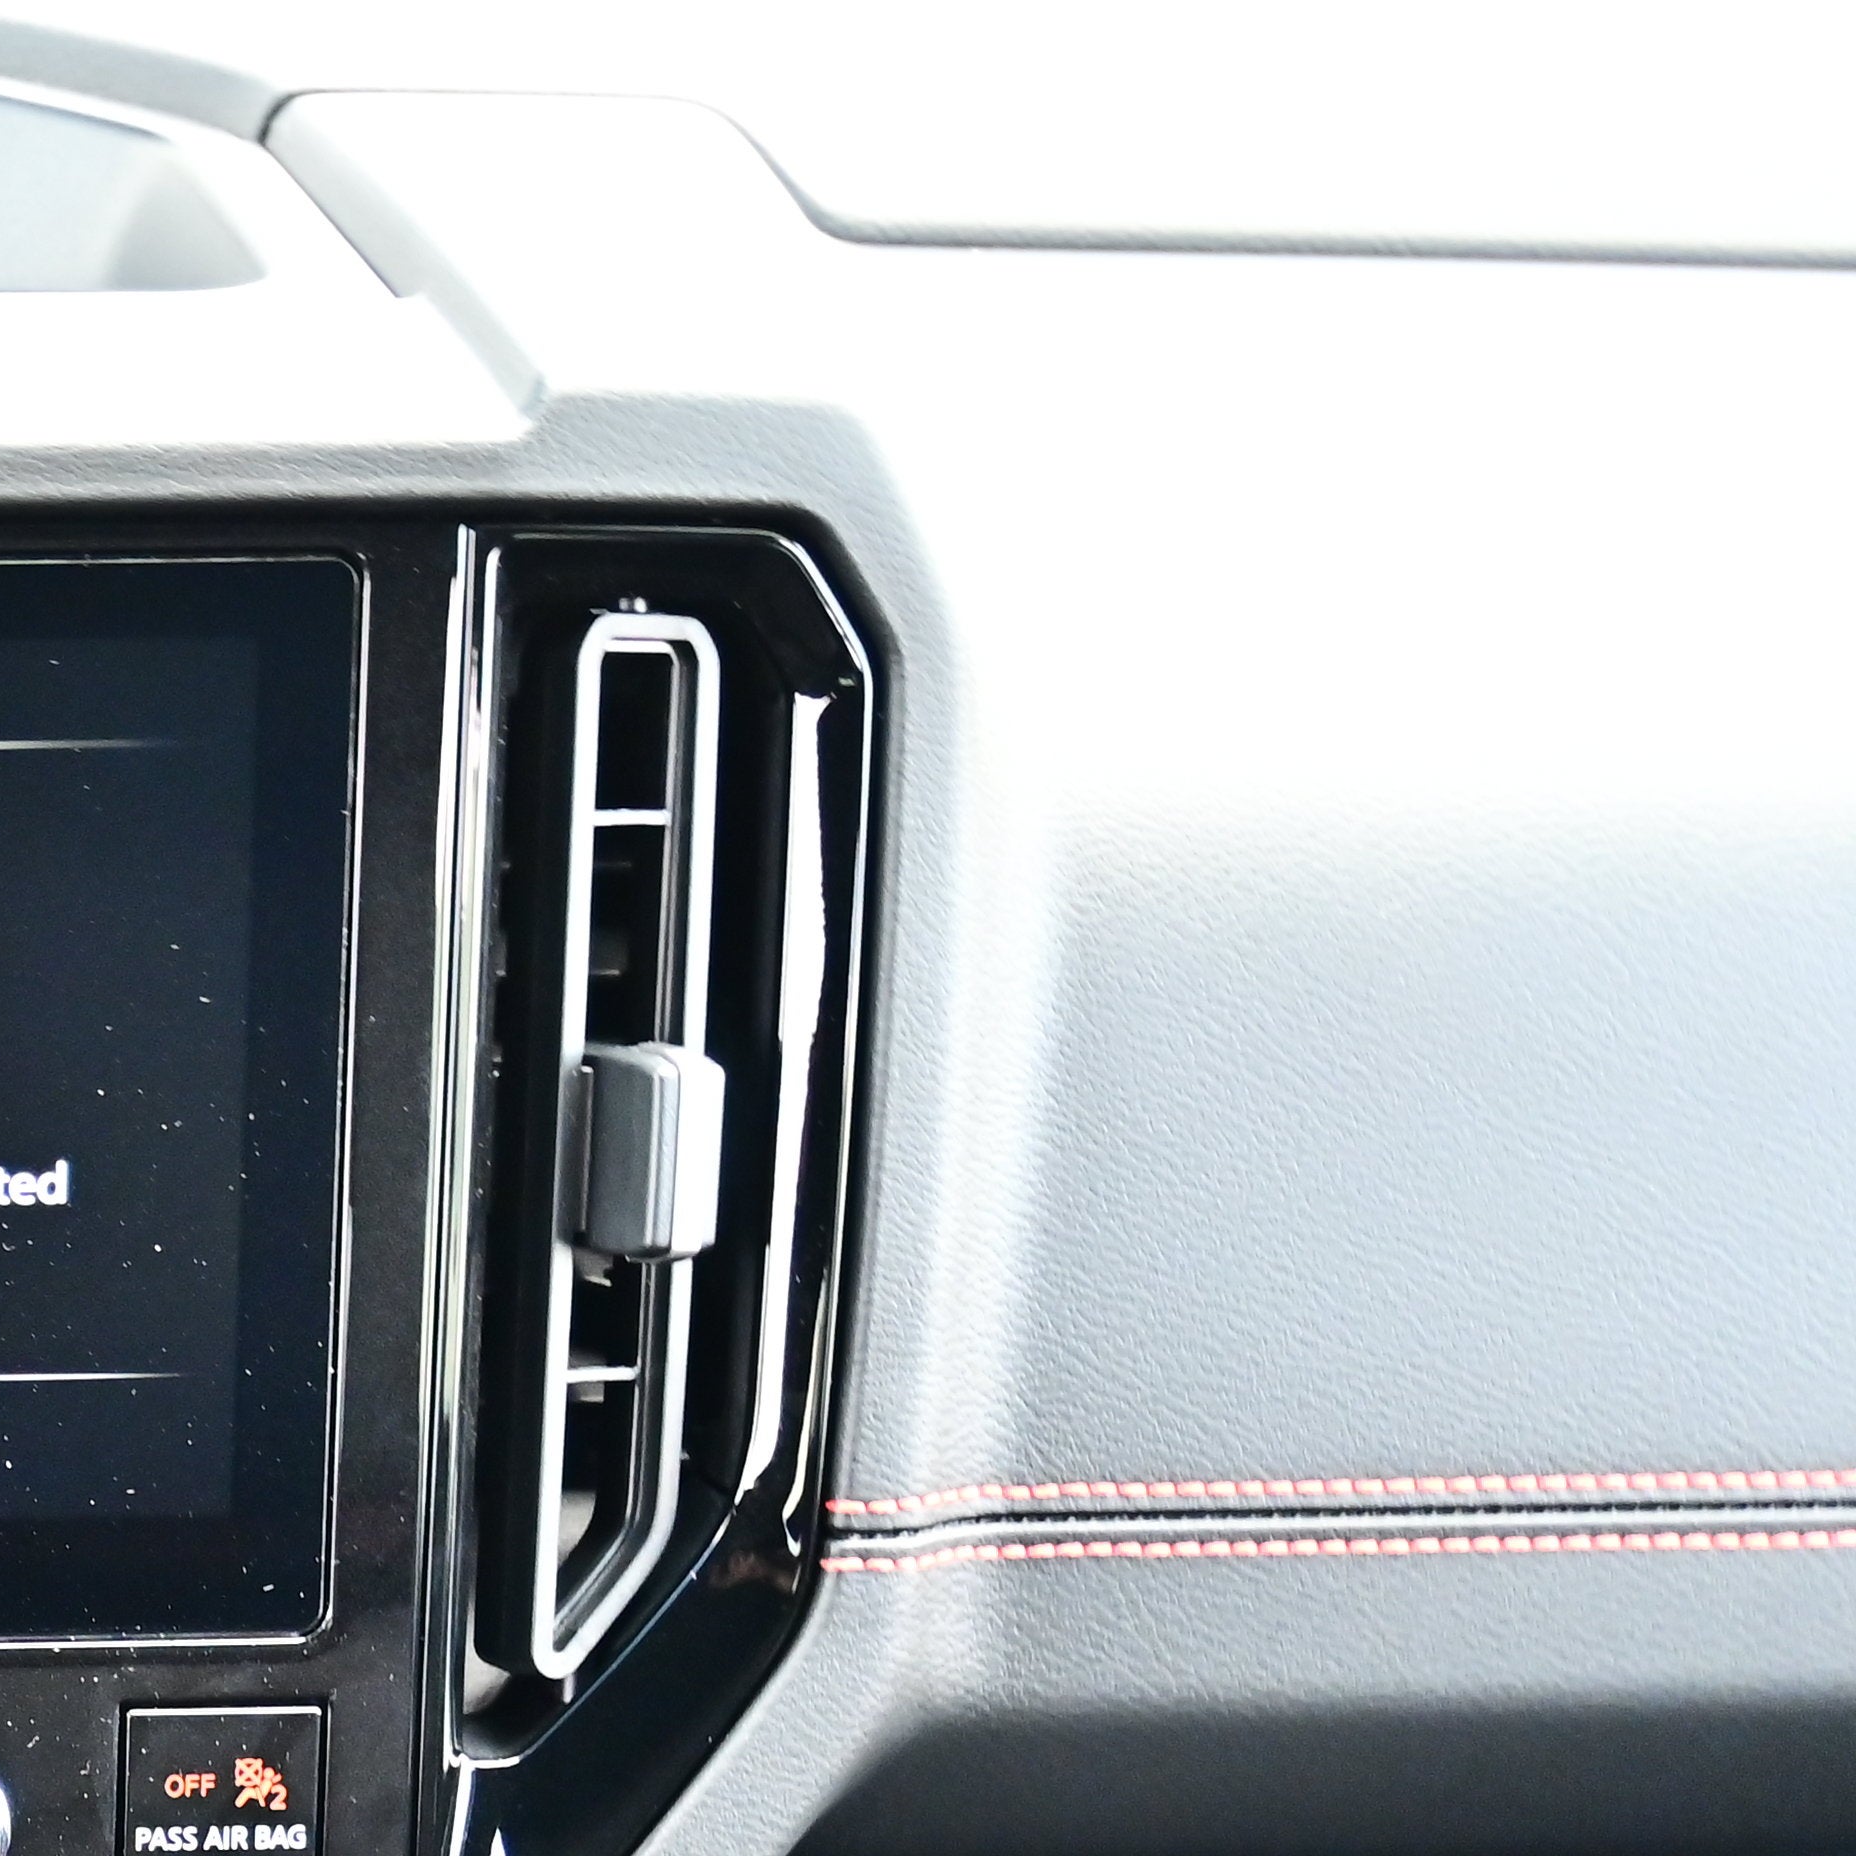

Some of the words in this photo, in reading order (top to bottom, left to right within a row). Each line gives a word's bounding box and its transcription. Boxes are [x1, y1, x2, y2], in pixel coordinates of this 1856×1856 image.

[165, 1772, 216, 1798] OFF
[135, 1826, 198, 1851] PASS
[203, 1825, 248, 1850] AIR
[255, 1824, 306, 1850] BAG
